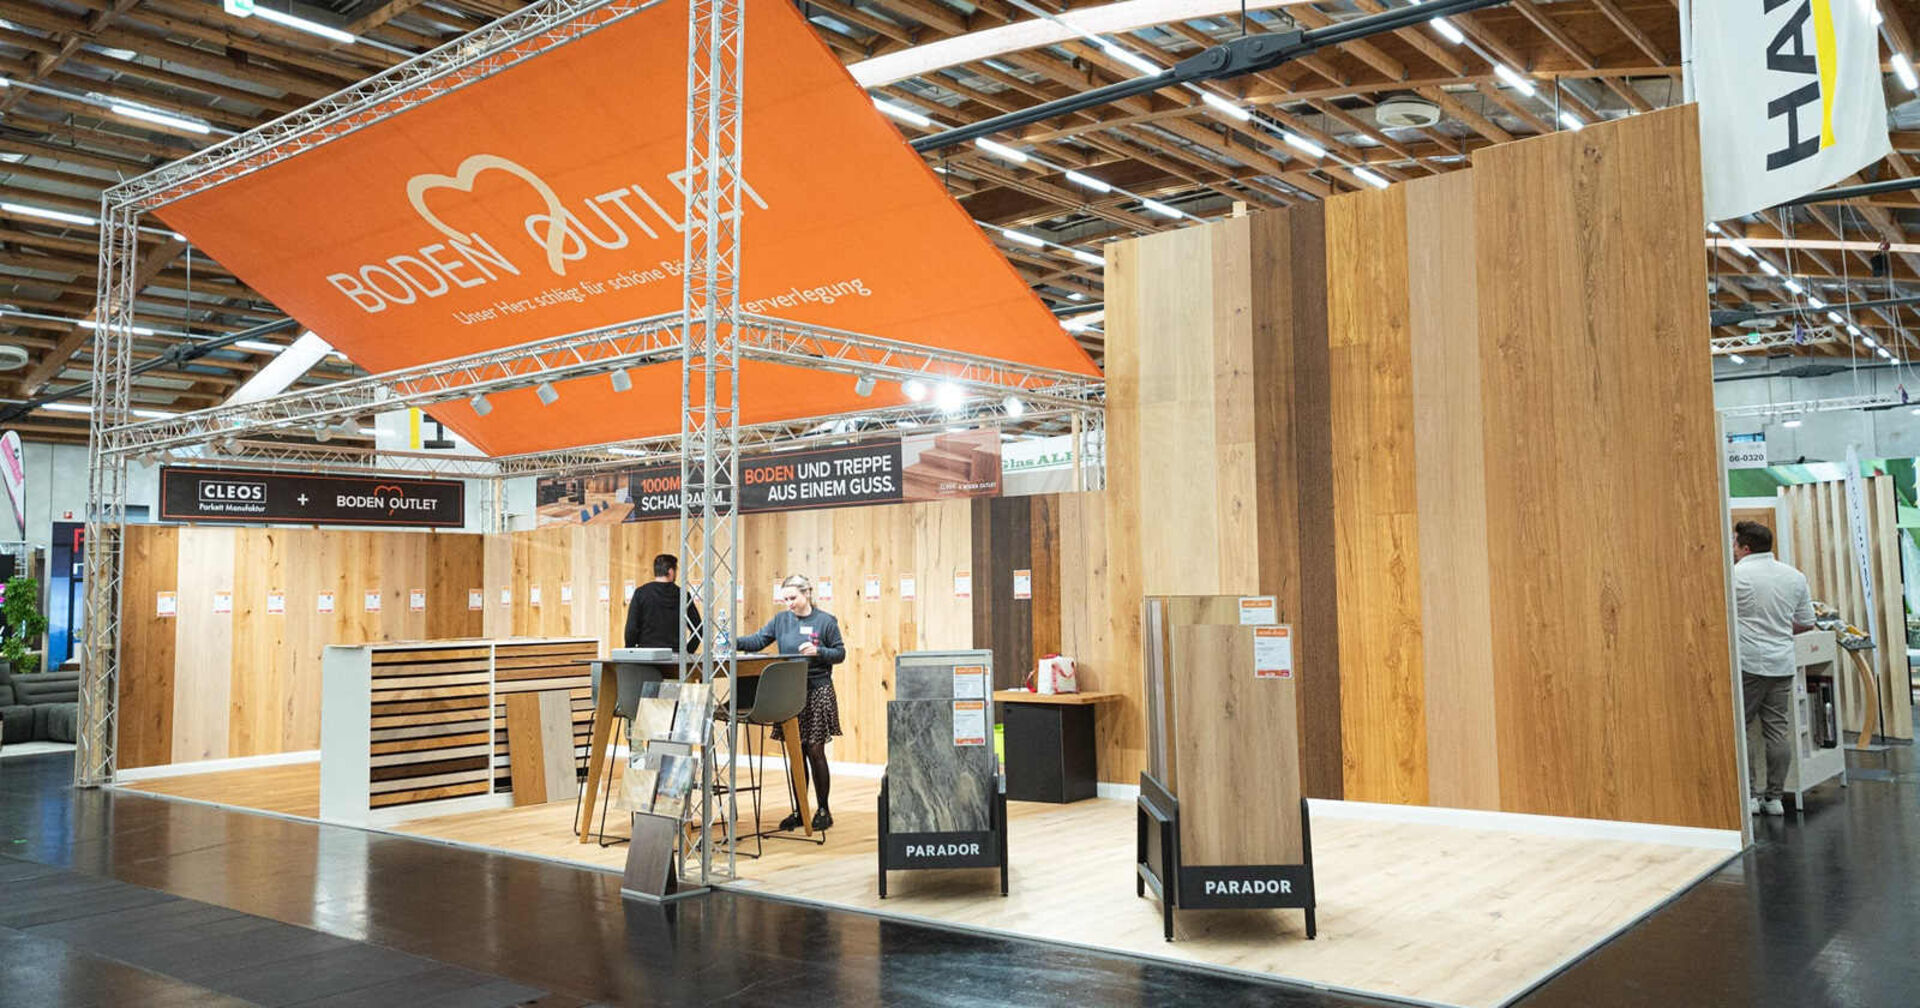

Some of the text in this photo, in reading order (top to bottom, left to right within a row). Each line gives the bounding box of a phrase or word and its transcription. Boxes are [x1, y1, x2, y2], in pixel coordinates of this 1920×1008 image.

[1763, 0, 1821, 171] HA
[326, 154, 769, 313] BODEN OUTLET
[452, 308, 498, 325] Unser
[493, 300, 536, 315] Herz
[579, 279, 606, 296] für
[607, 269, 666, 290] schöne
[744, 455, 892, 484] BODEN UND TREPPE
[204, 484, 262, 500] CLEOS
[767, 476, 896, 502] AUS EINEM GUSS.
[336, 495, 438, 510] BODEN OUTLET
[905, 843, 980, 858] PARADOR
[1205, 879, 1292, 895] PARADOR
